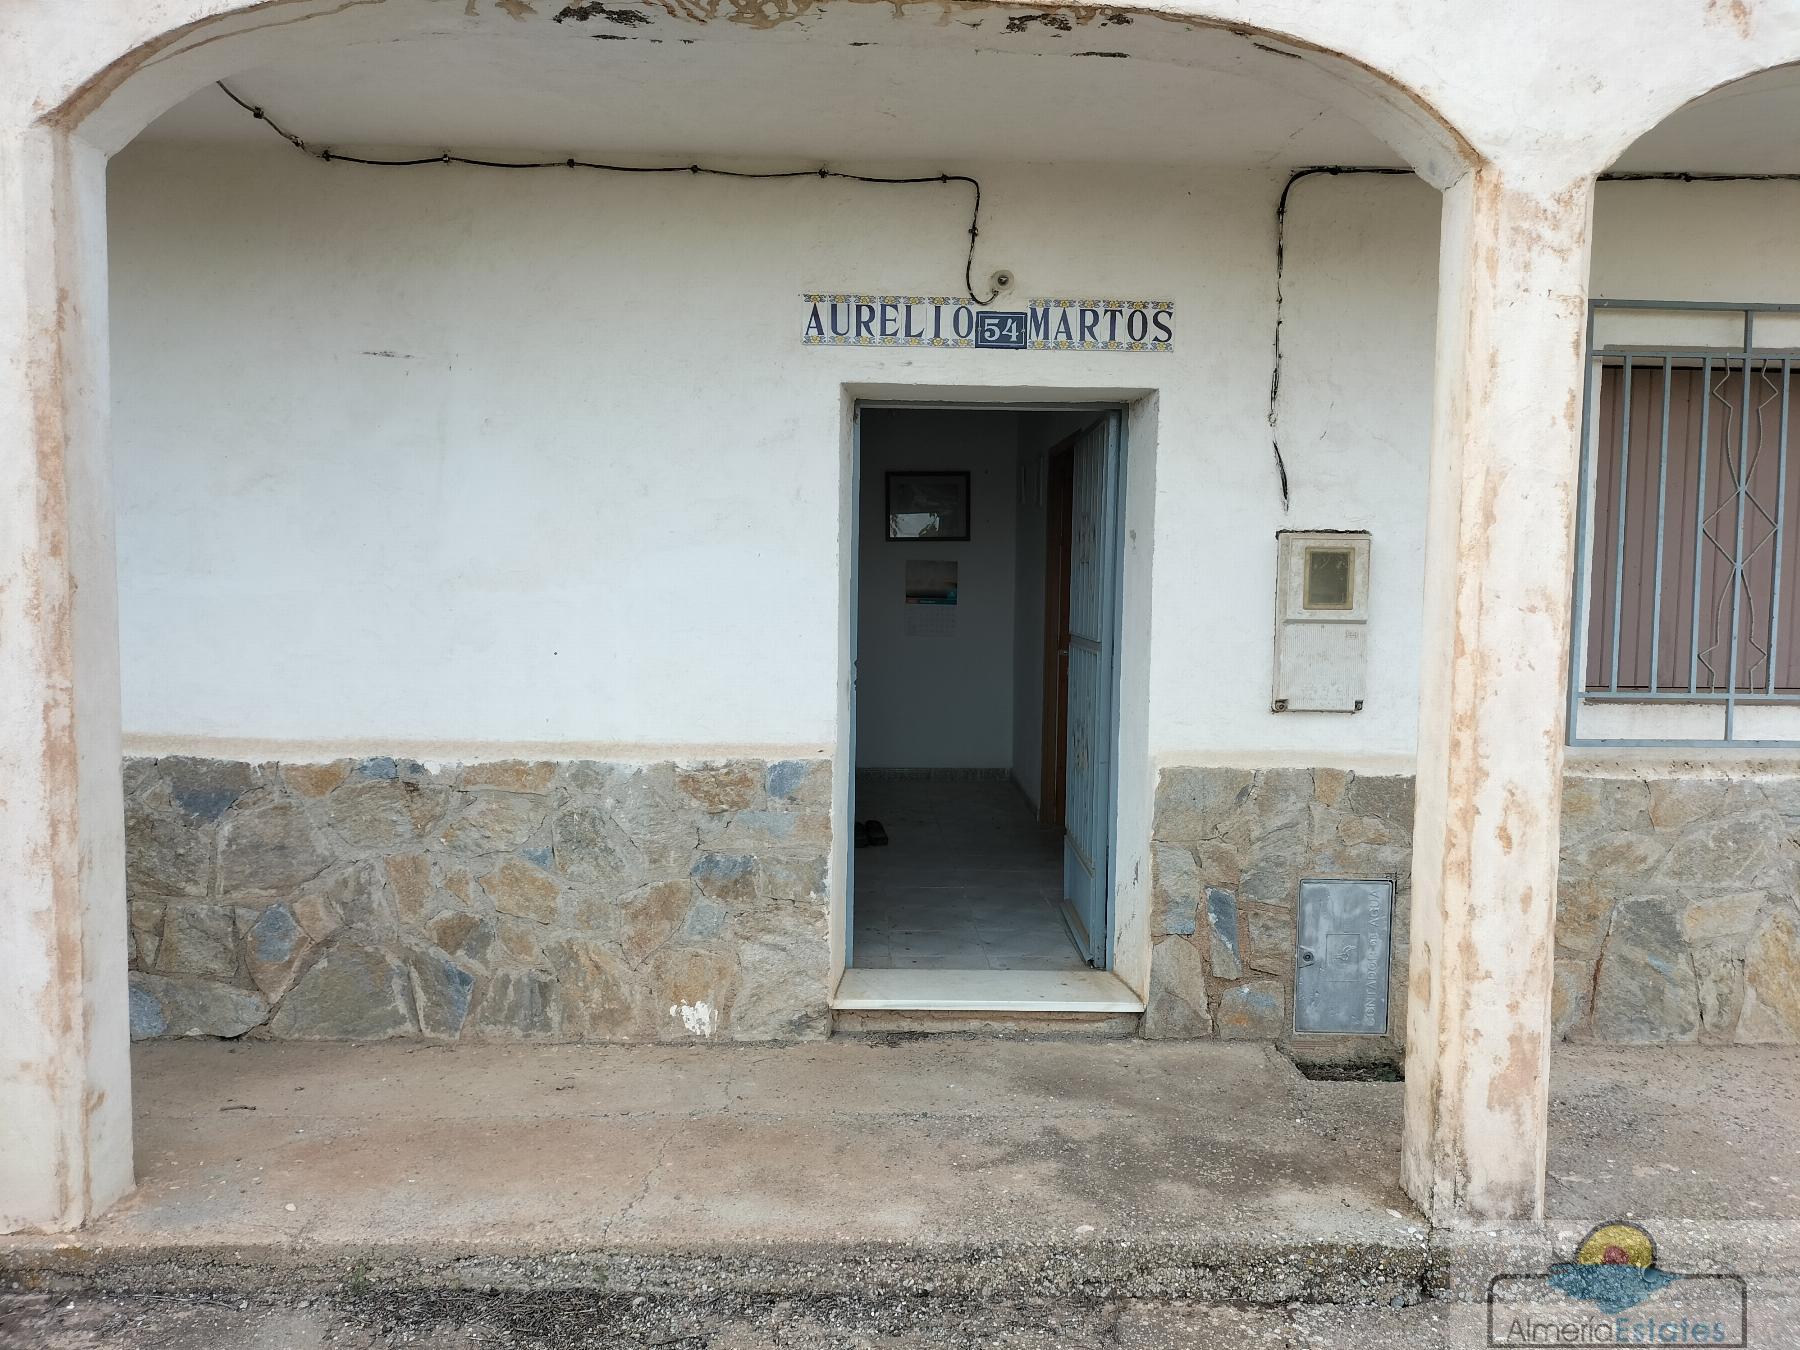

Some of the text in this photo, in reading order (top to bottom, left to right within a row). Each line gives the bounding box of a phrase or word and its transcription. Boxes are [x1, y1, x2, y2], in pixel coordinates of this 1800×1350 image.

[804, 302, 1174, 343] AURELIO 54 MARTOS
[1368, 890, 1382, 928] AGUA
[1366, 951, 1378, 1027] CONTADOR
